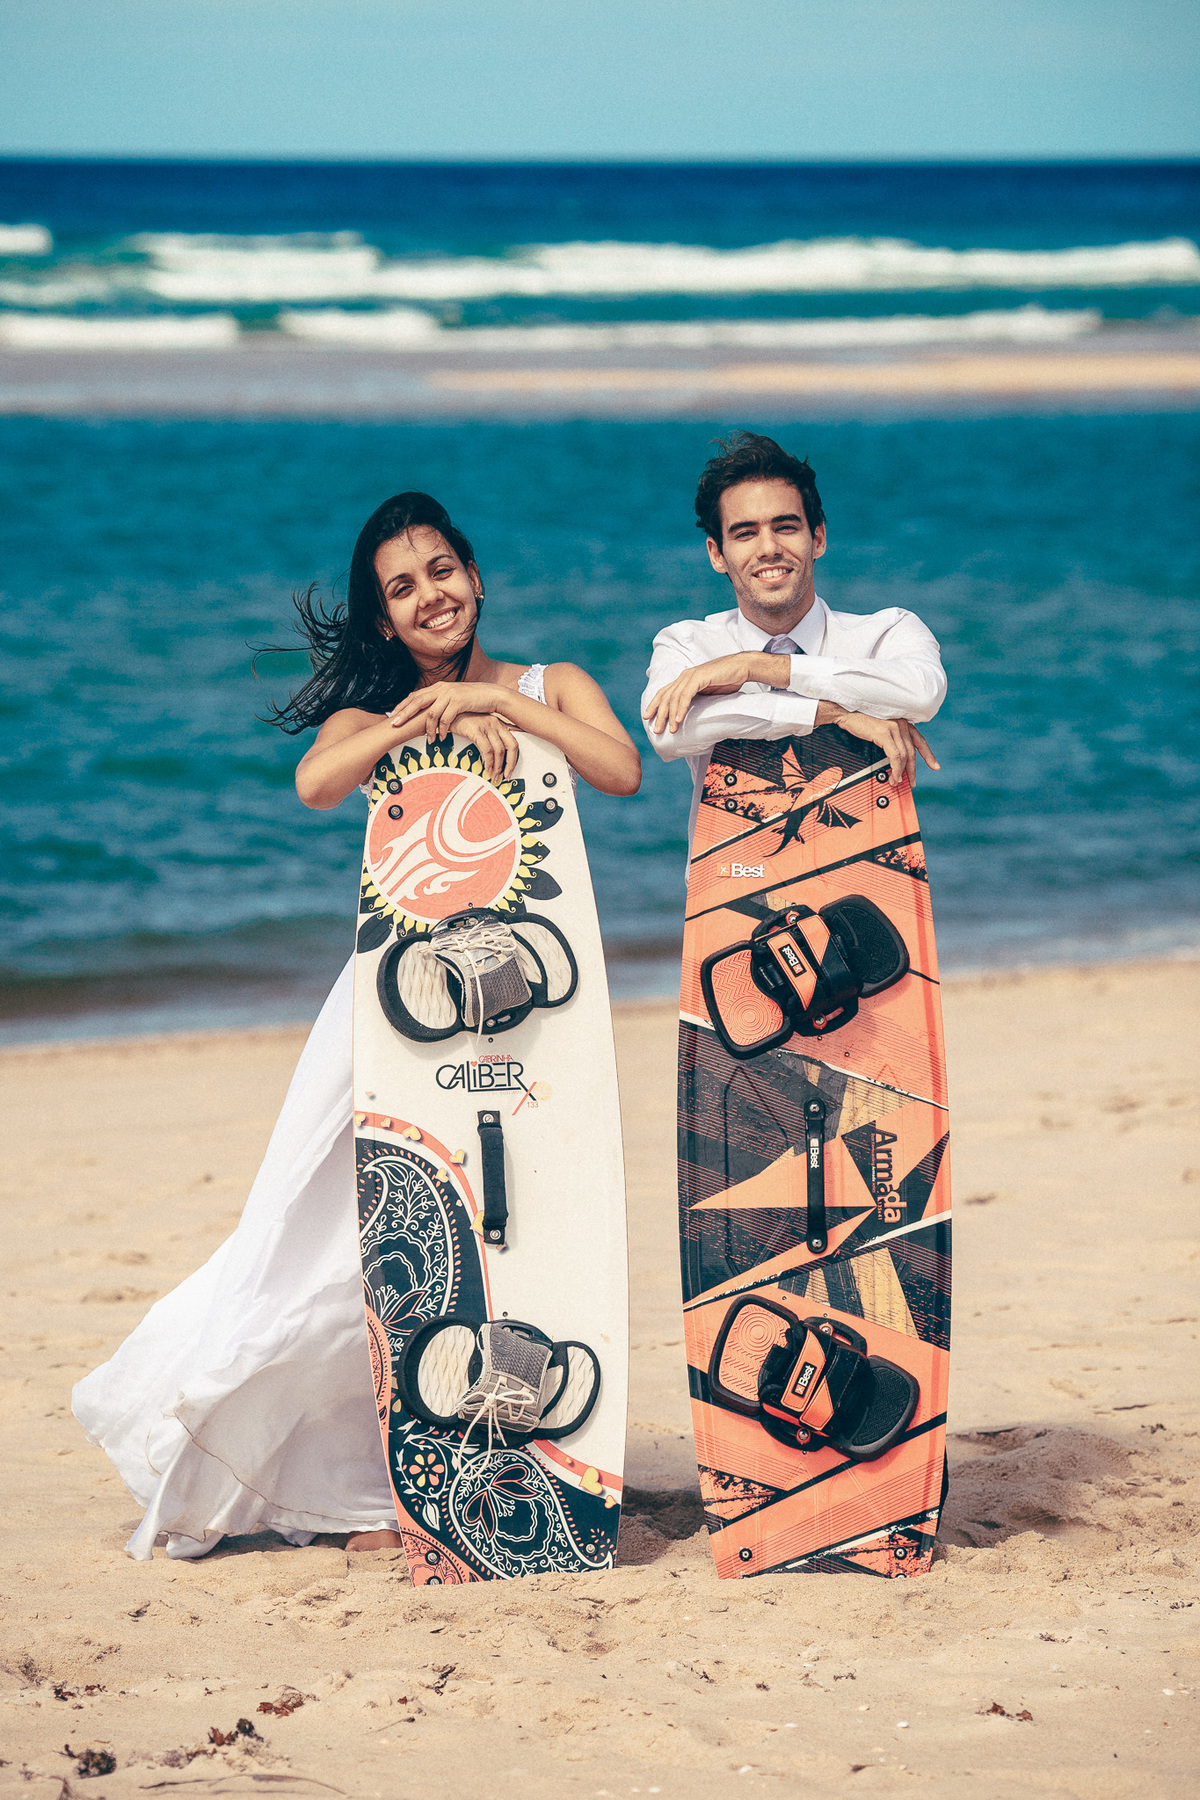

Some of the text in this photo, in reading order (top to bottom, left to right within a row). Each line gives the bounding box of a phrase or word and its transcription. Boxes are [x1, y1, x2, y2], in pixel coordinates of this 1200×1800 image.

[731, 863, 765, 878] Best
[781, 945, 800, 967] Best
[478, 1054, 514, 1063] CABRINHA
[527, 1101, 539, 1109] 133
[810, 1147, 819, 1168] Best
[875, 1127, 907, 1223] Armada
[798, 1365, 815, 1387] Best
